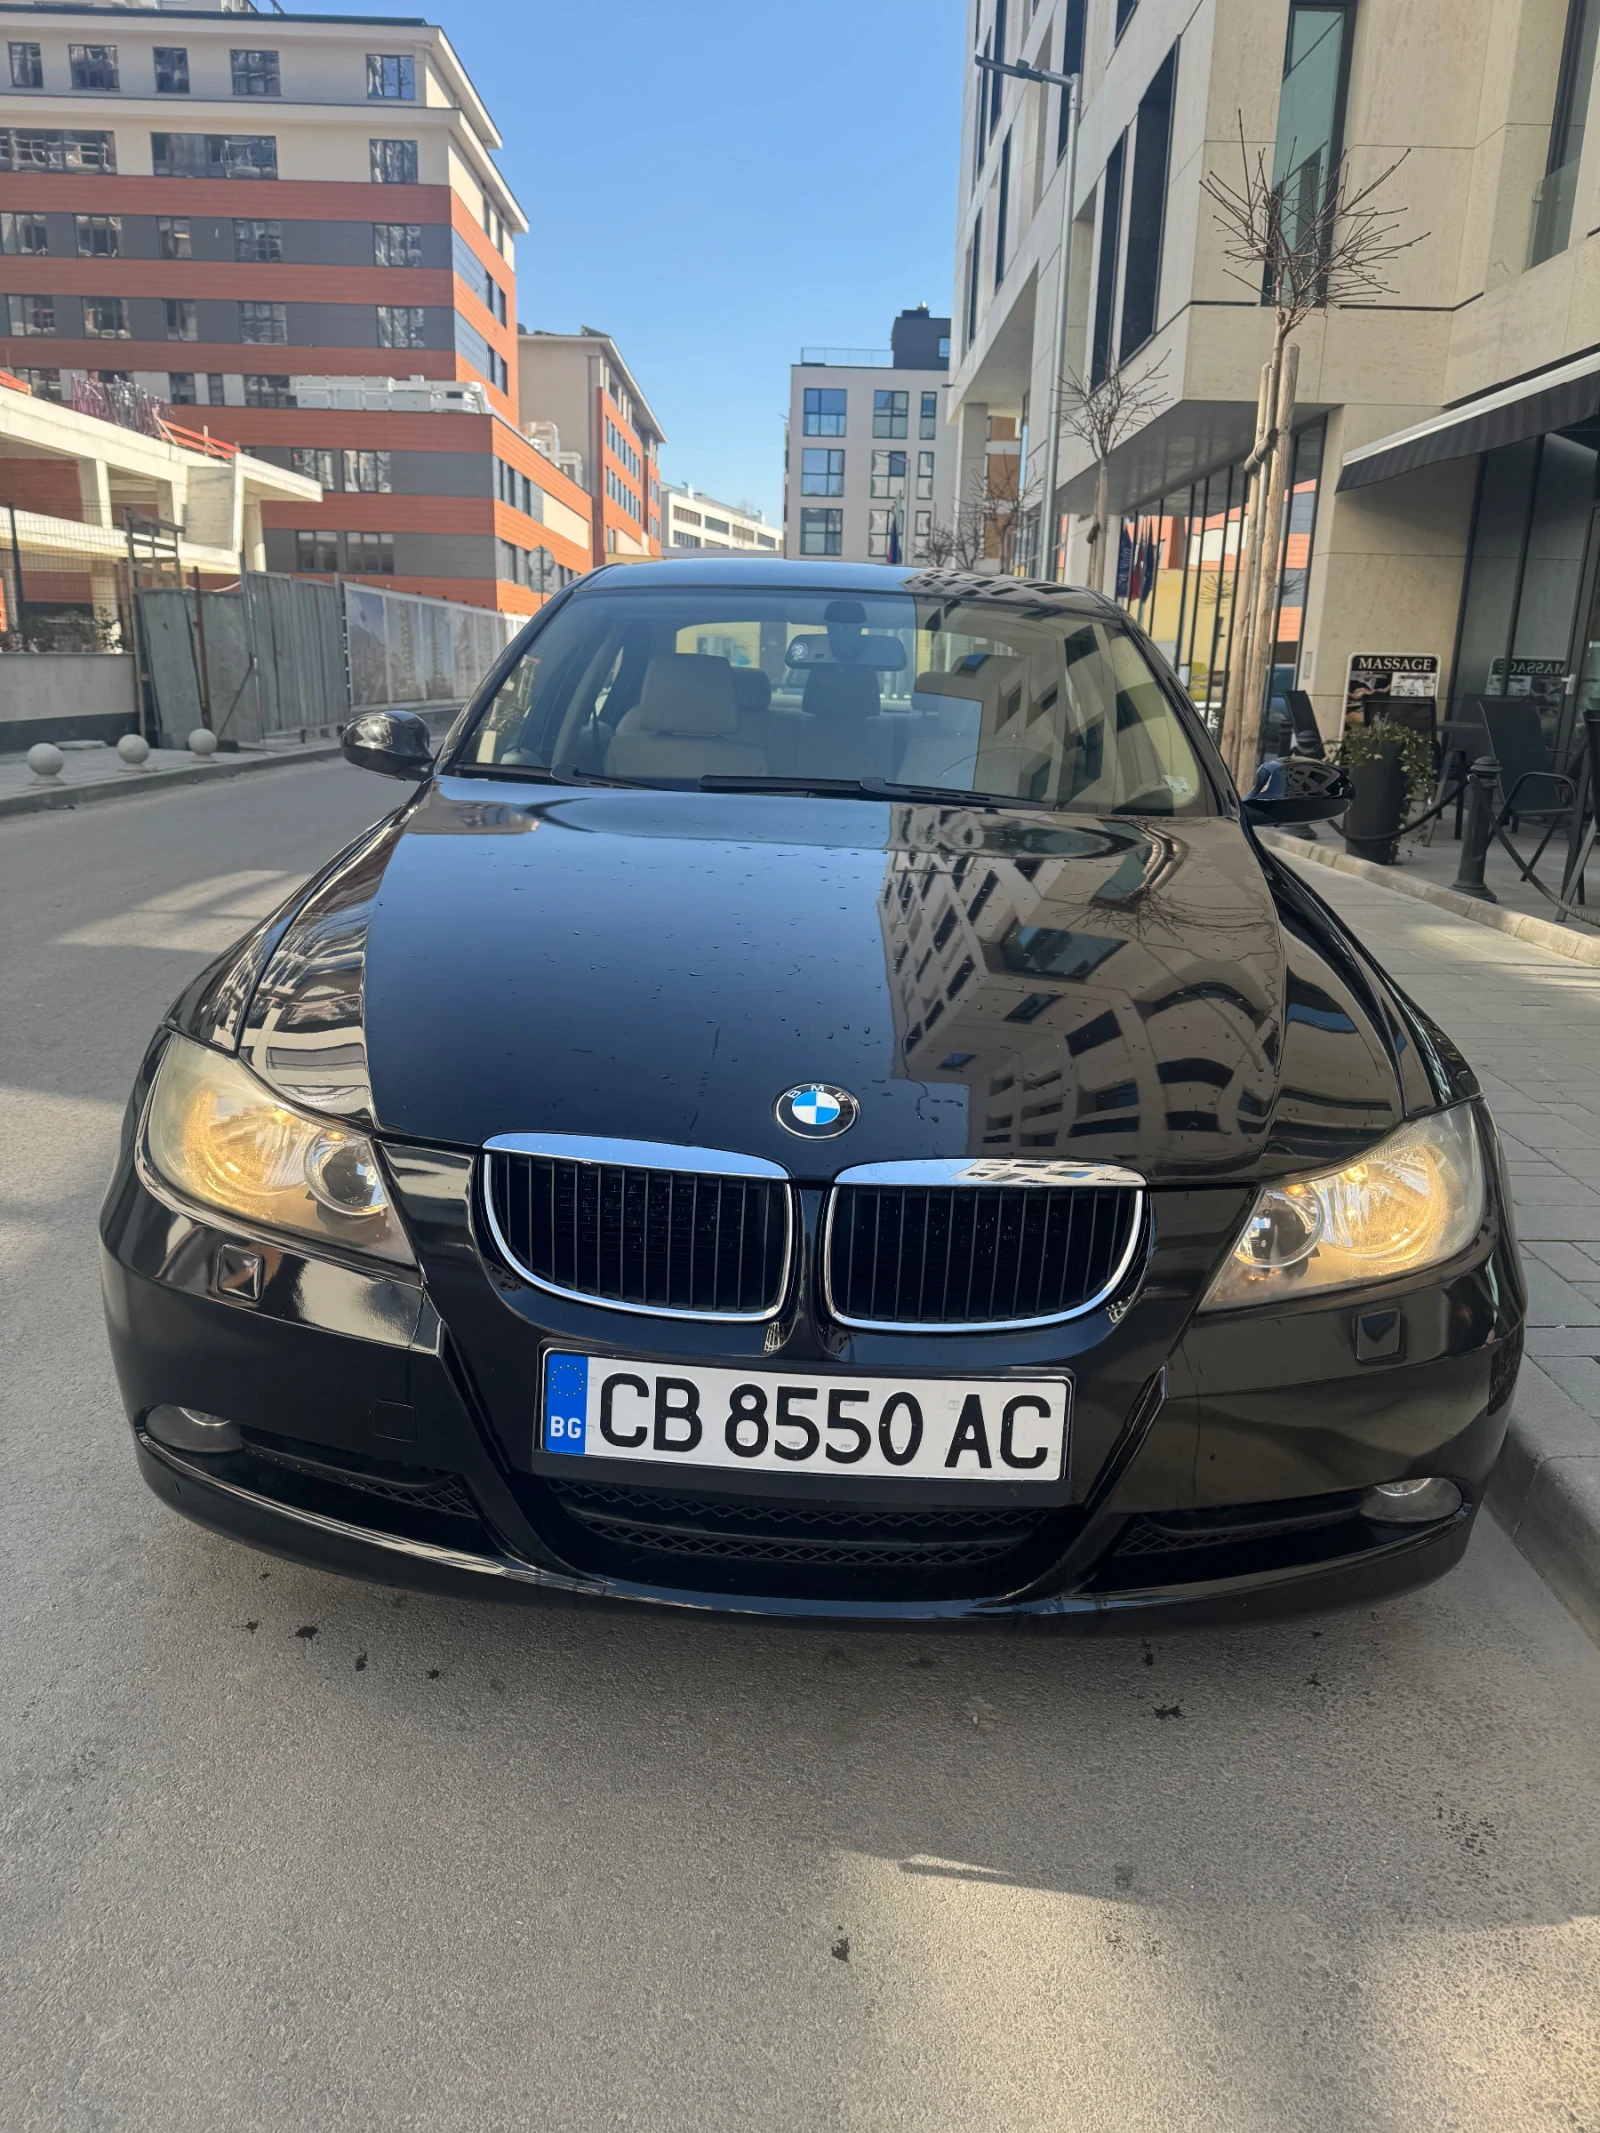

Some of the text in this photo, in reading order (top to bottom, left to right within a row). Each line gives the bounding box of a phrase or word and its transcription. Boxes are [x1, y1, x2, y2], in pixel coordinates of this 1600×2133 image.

[1358, 657, 1432, 671] MASSAGE
[787, 1084, 849, 1102] BMW
[549, 1415, 582, 1439] BG
[600, 1373, 1051, 1469] CB 8550 AC
